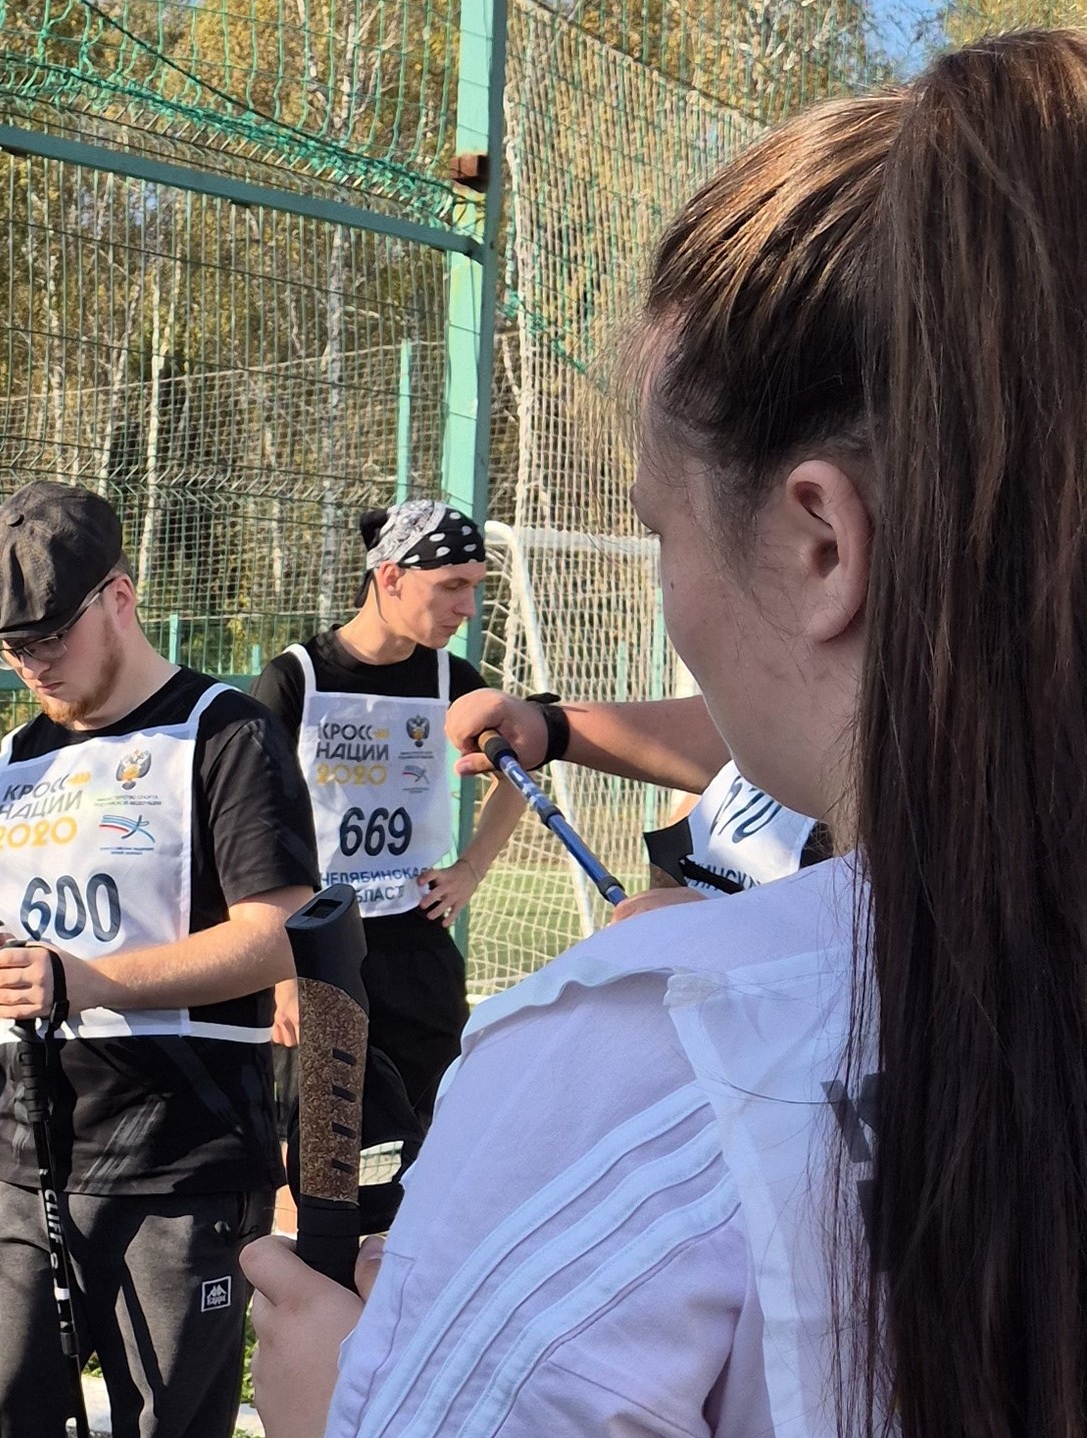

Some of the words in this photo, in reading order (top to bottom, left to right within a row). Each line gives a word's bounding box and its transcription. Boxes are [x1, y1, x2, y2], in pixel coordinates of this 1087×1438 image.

[317, 722, 373, 741] КРОСС
[315, 741, 389, 763] НАЦИИ
[2, 772, 71, 802] КРОСС
[316, 762, 388, 786] 2020
[339, 806, 412, 857] 669
[19, 872, 121, 943] 600
[43, 1188, 64, 1246] CLIFF
